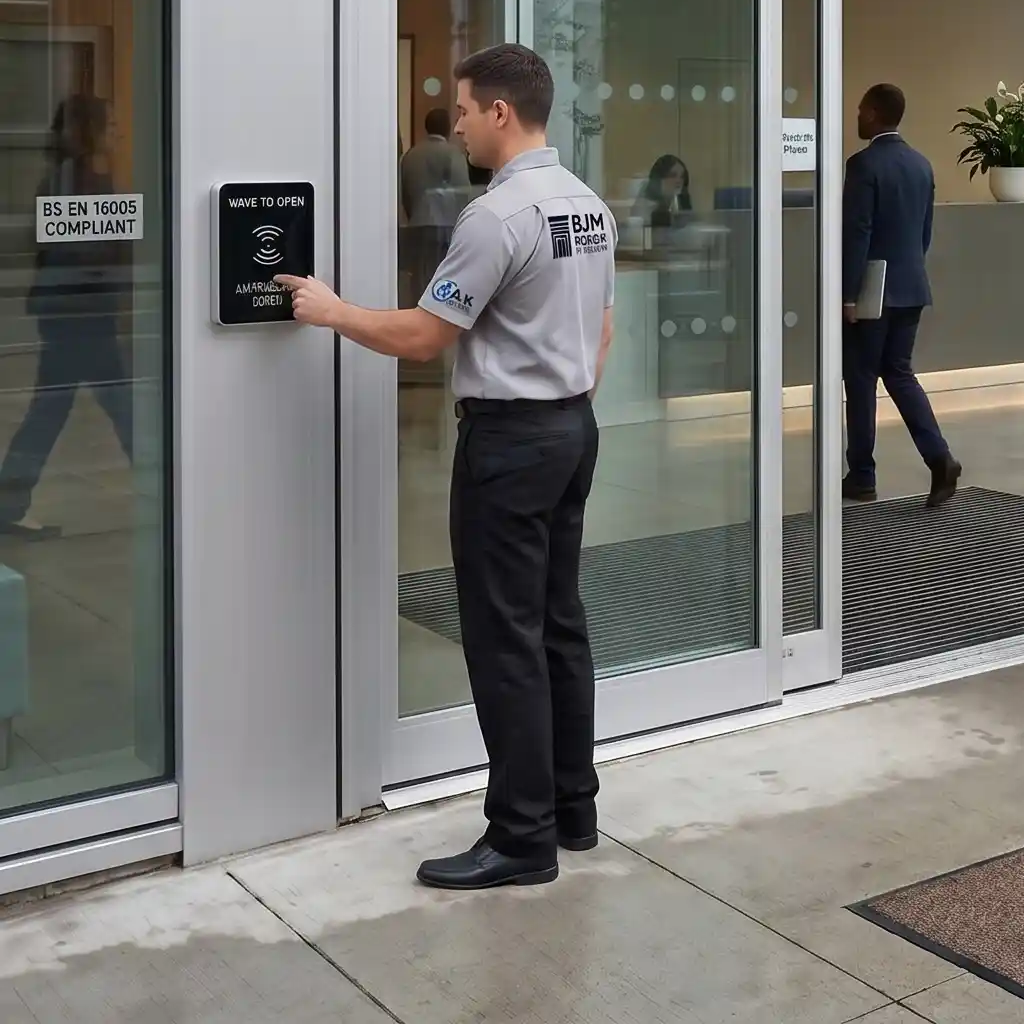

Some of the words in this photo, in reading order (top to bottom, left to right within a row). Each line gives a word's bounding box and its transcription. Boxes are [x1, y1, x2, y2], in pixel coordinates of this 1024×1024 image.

[43, 202, 62, 217] BS
[68, 201, 88, 216] EN
[93, 200, 137, 215] 16005
[228, 197, 258, 208] WAVE
[260, 197, 274, 207] TO
[276, 196, 305, 207] OPEN
[45, 219, 136, 236] COMPLIANT
[571, 212, 605, 234] BJM
